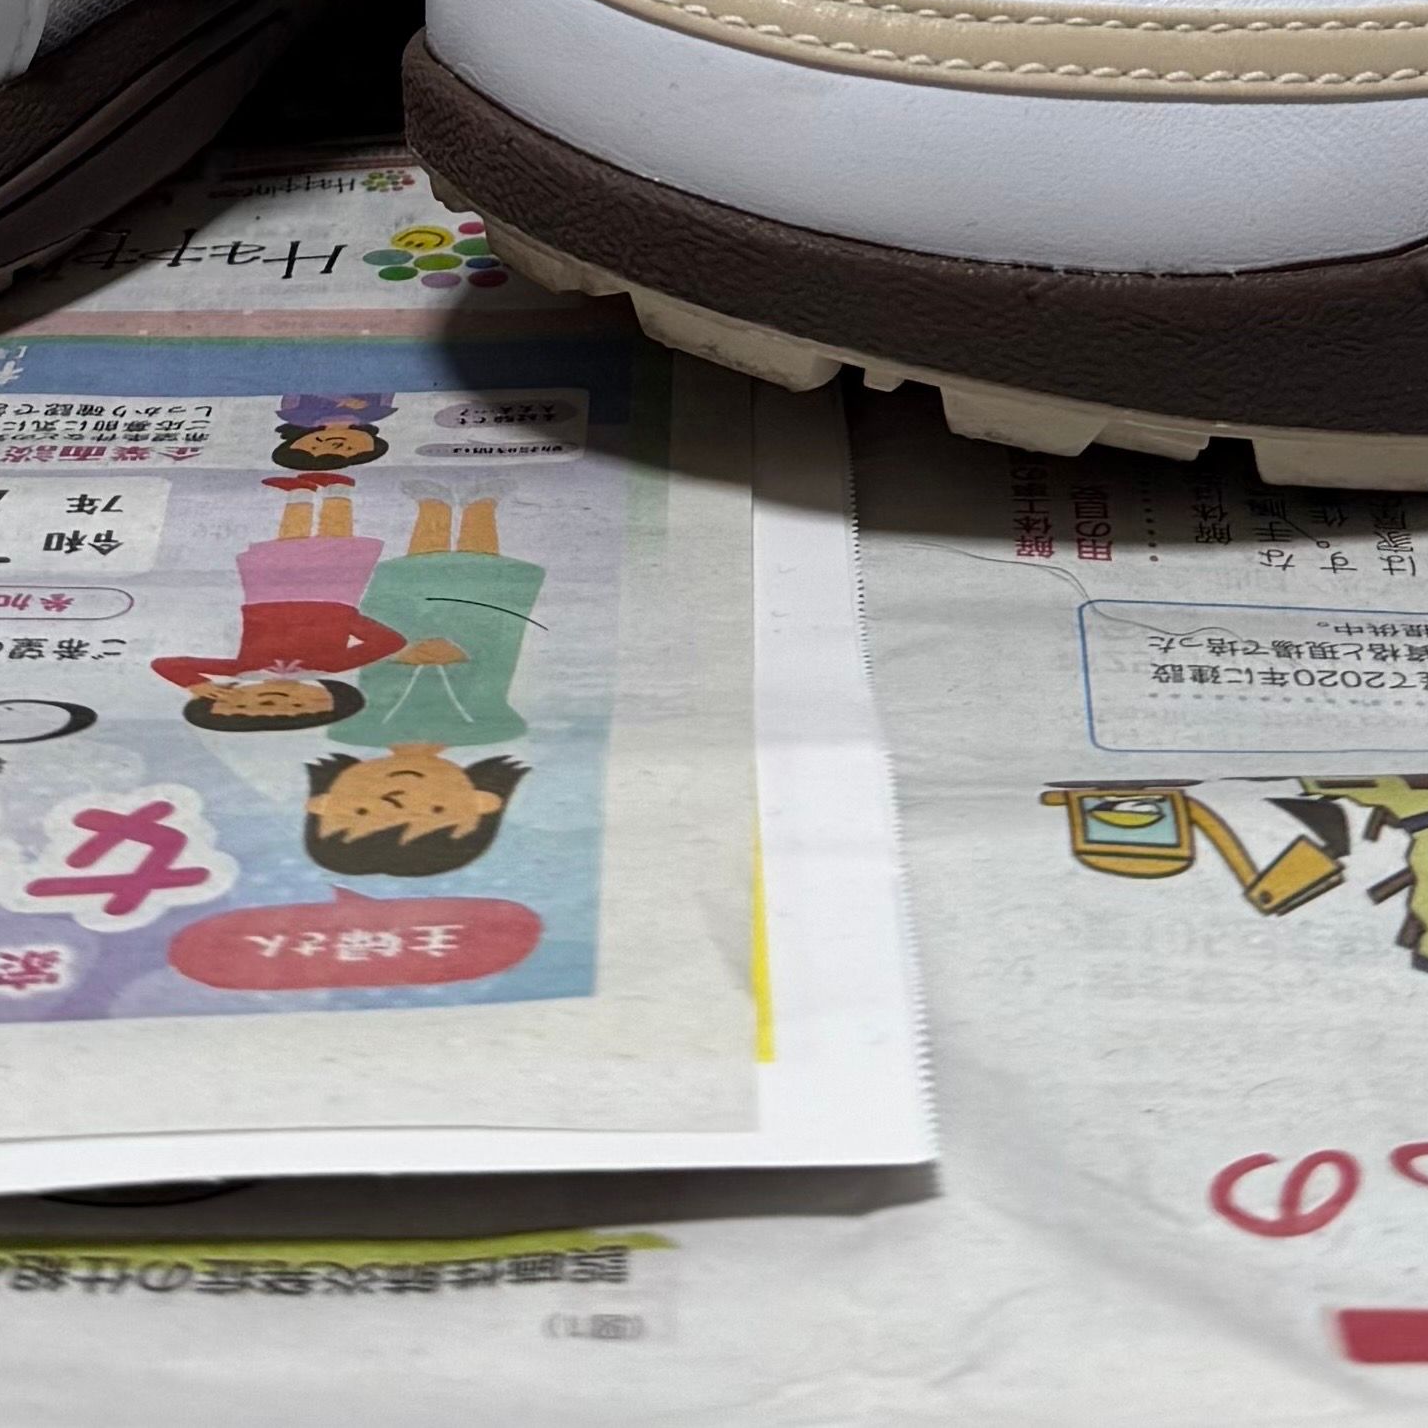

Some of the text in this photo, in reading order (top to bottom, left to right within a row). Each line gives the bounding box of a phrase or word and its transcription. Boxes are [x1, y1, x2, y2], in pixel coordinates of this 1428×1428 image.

[64, 492, 124, 516] 7年
[43, 530, 124, 556] 令和
[244, 924, 466, 960] 主婦さん
